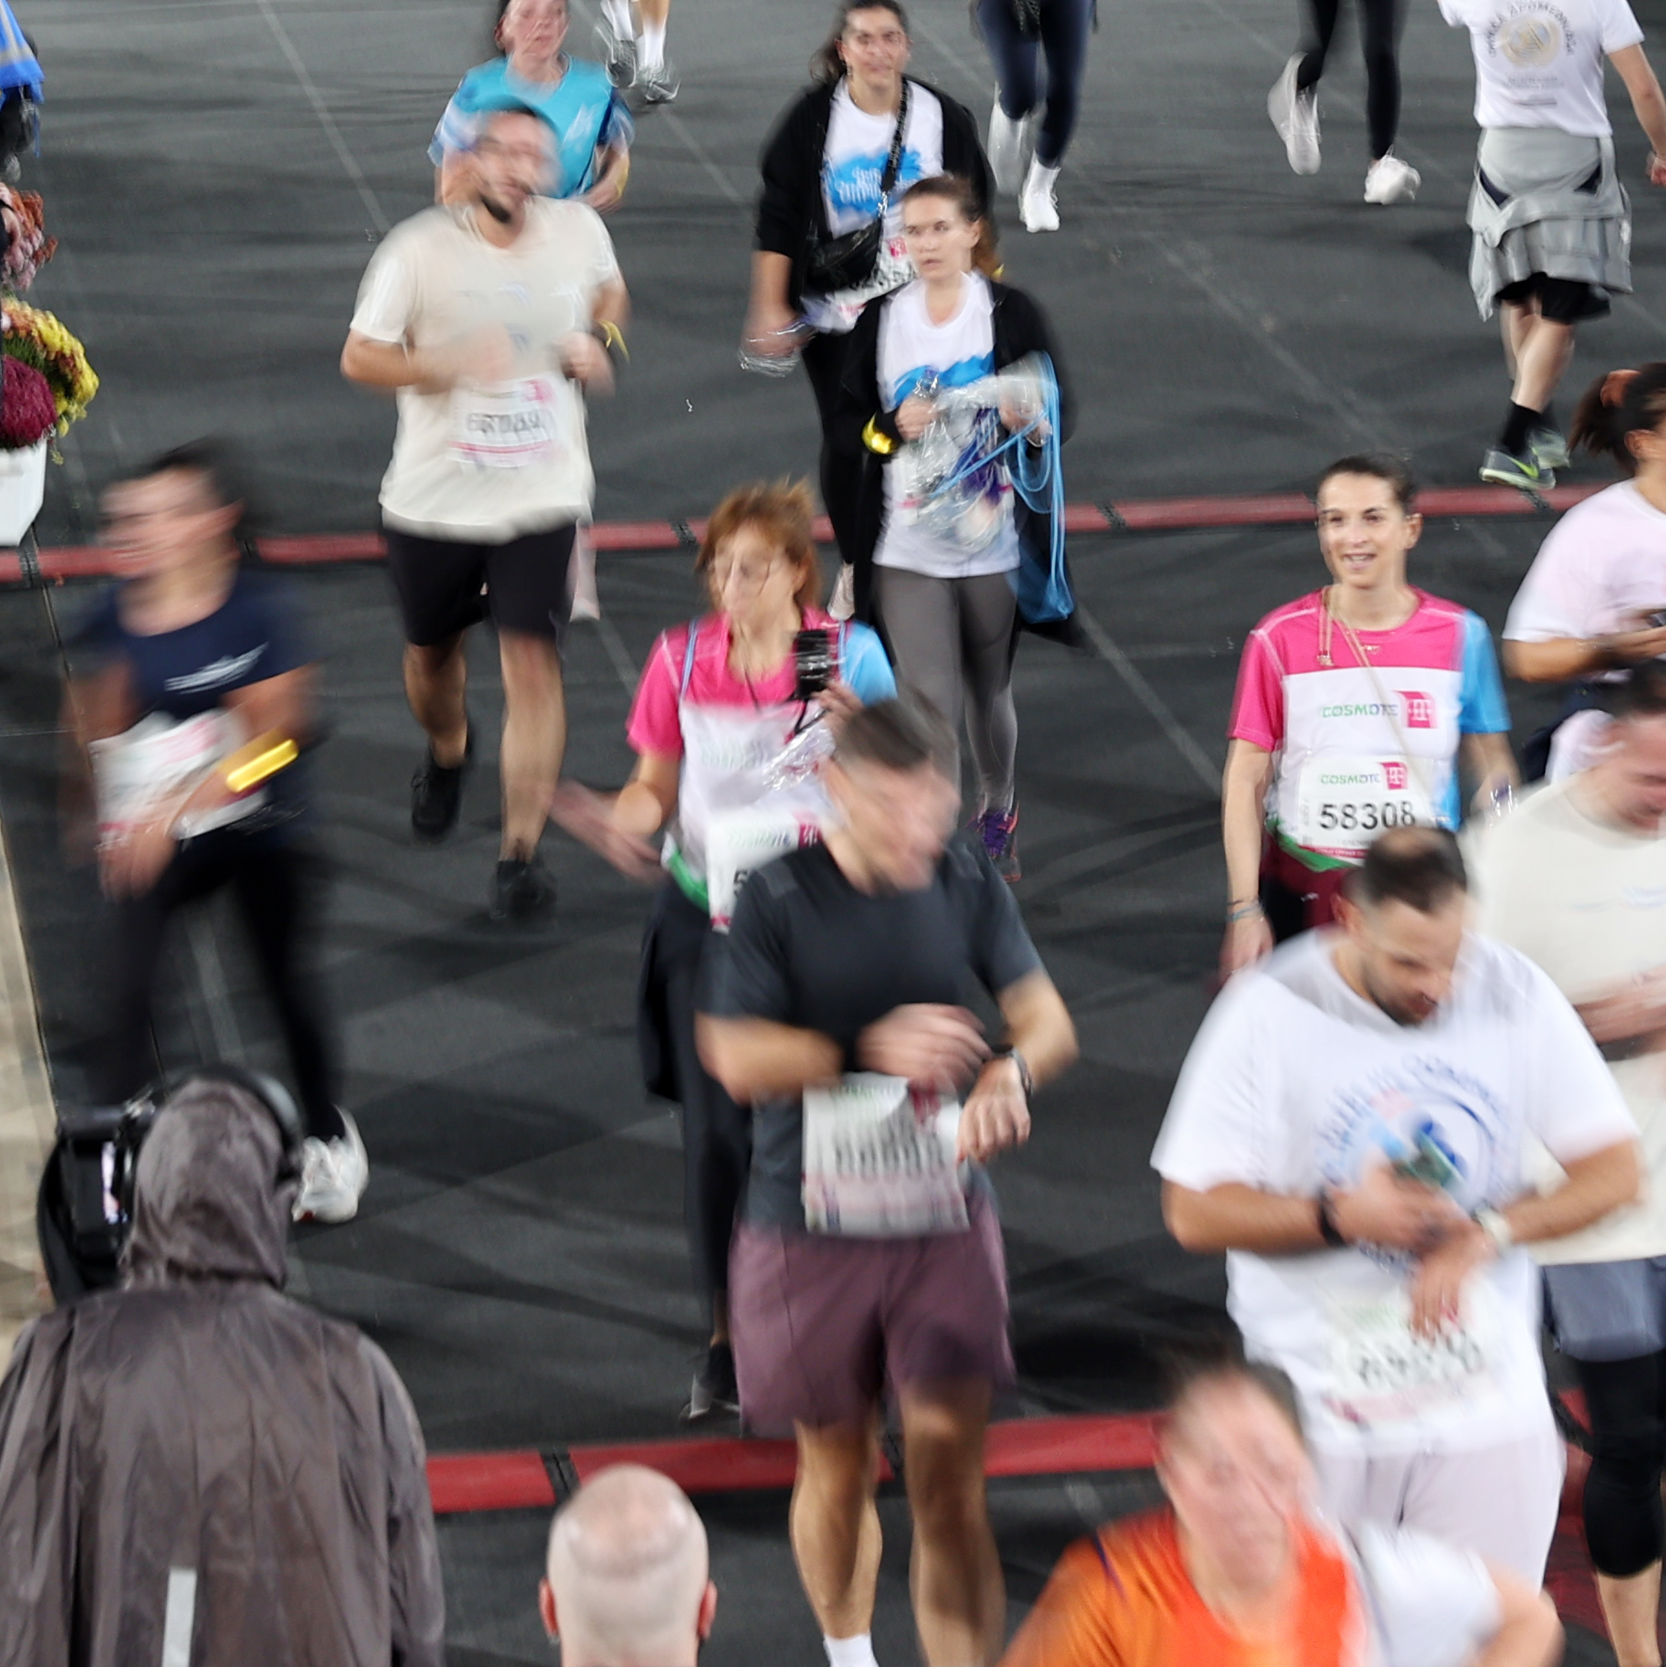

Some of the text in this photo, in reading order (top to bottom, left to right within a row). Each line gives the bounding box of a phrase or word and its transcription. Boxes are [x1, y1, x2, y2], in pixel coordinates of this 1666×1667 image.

[1319, 702, 1399, 718] COSMOTE
[1319, 773, 1381, 786] COSMOTE
[1318, 800, 1417, 831] 58308
